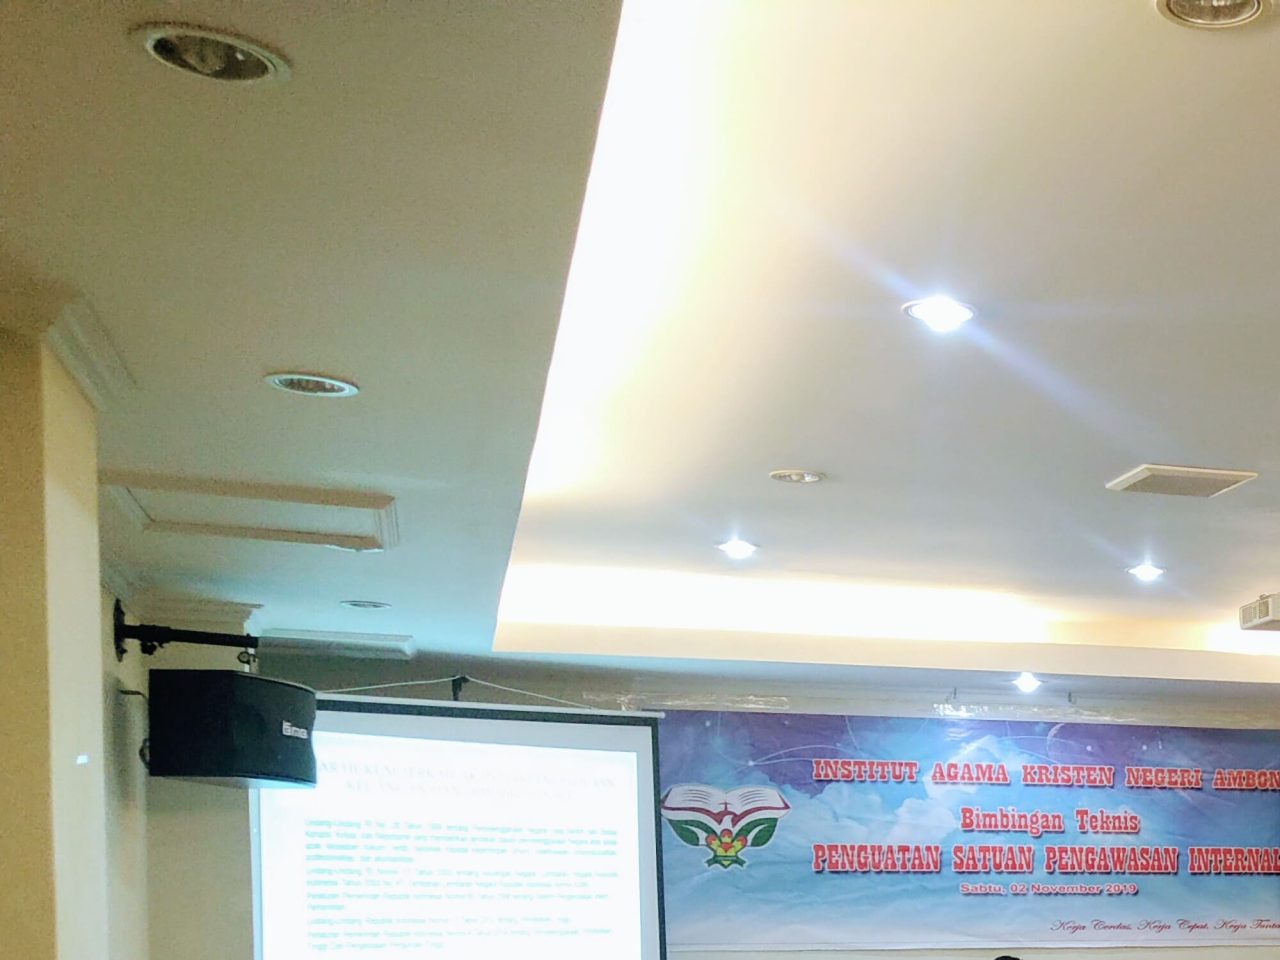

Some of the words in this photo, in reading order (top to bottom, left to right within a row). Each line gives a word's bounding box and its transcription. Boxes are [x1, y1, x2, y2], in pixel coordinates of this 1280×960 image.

[813, 759, 918, 781] INSTITUT
[931, 763, 1009, 784] AGAMA
[1022, 765, 1114, 786] KRISTEN
[1125, 767, 1203, 788] NEGERI
[960, 806, 1063, 837] Bimbingan
[1075, 809, 1140, 832] Teknis
[812, 843, 941, 872] PENGUATAN
[953, 845, 1034, 872] SATUAN
[1044, 846, 1178, 873] PENGAWASAN
[960, 883, 1006, 895] Sabtu,
[1010, 884, 1027, 893] 02
[1031, 883, 1101, 894] November
[1105, 884, 1138, 894] 2019
[1050, 919, 1086, 934] Kerja
[1137, 919, 1171, 933] Kerja
[1214, 919, 1247, 933] Kerja
